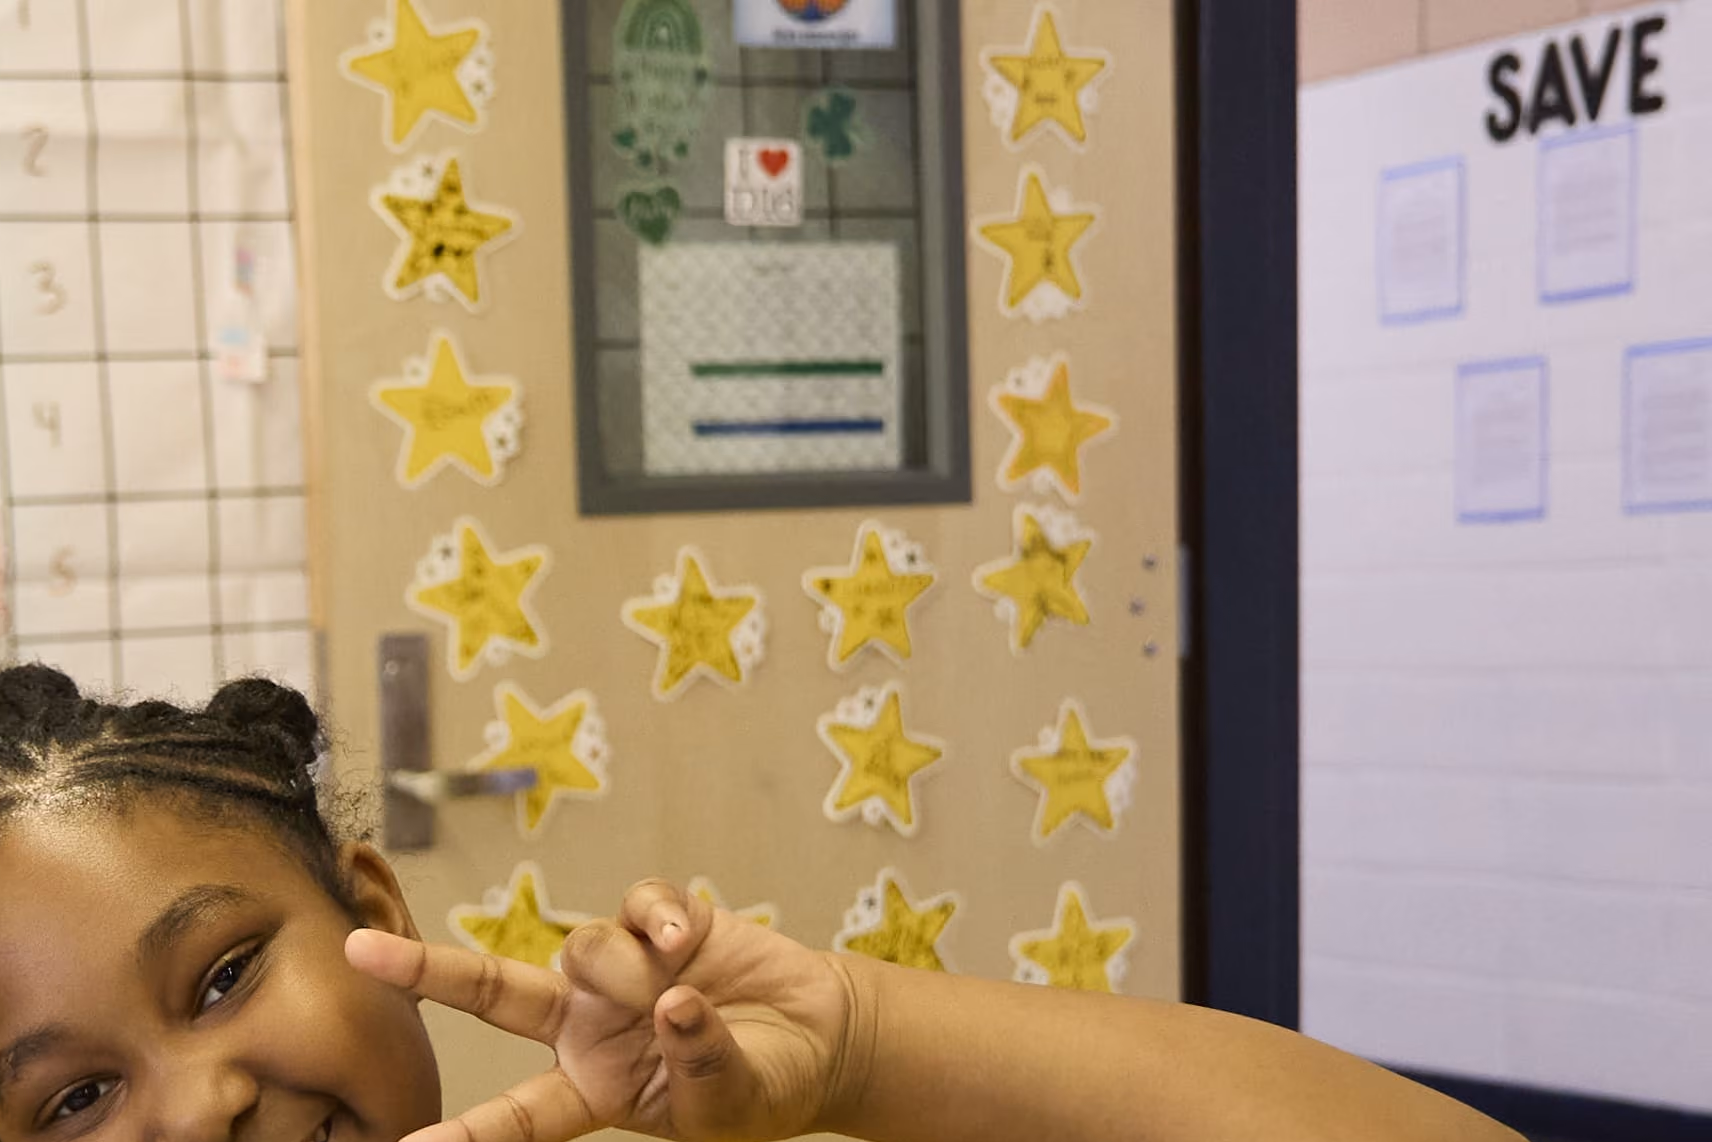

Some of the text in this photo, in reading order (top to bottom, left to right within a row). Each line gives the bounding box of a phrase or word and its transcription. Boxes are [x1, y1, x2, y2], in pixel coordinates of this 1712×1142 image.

[1486, 14, 1668, 143] SAVE
[21, 124, 50, 177] 2
[27, 261, 67, 315] 3
[32, 400, 63, 448] 4
[46, 544, 79, 598] 5
